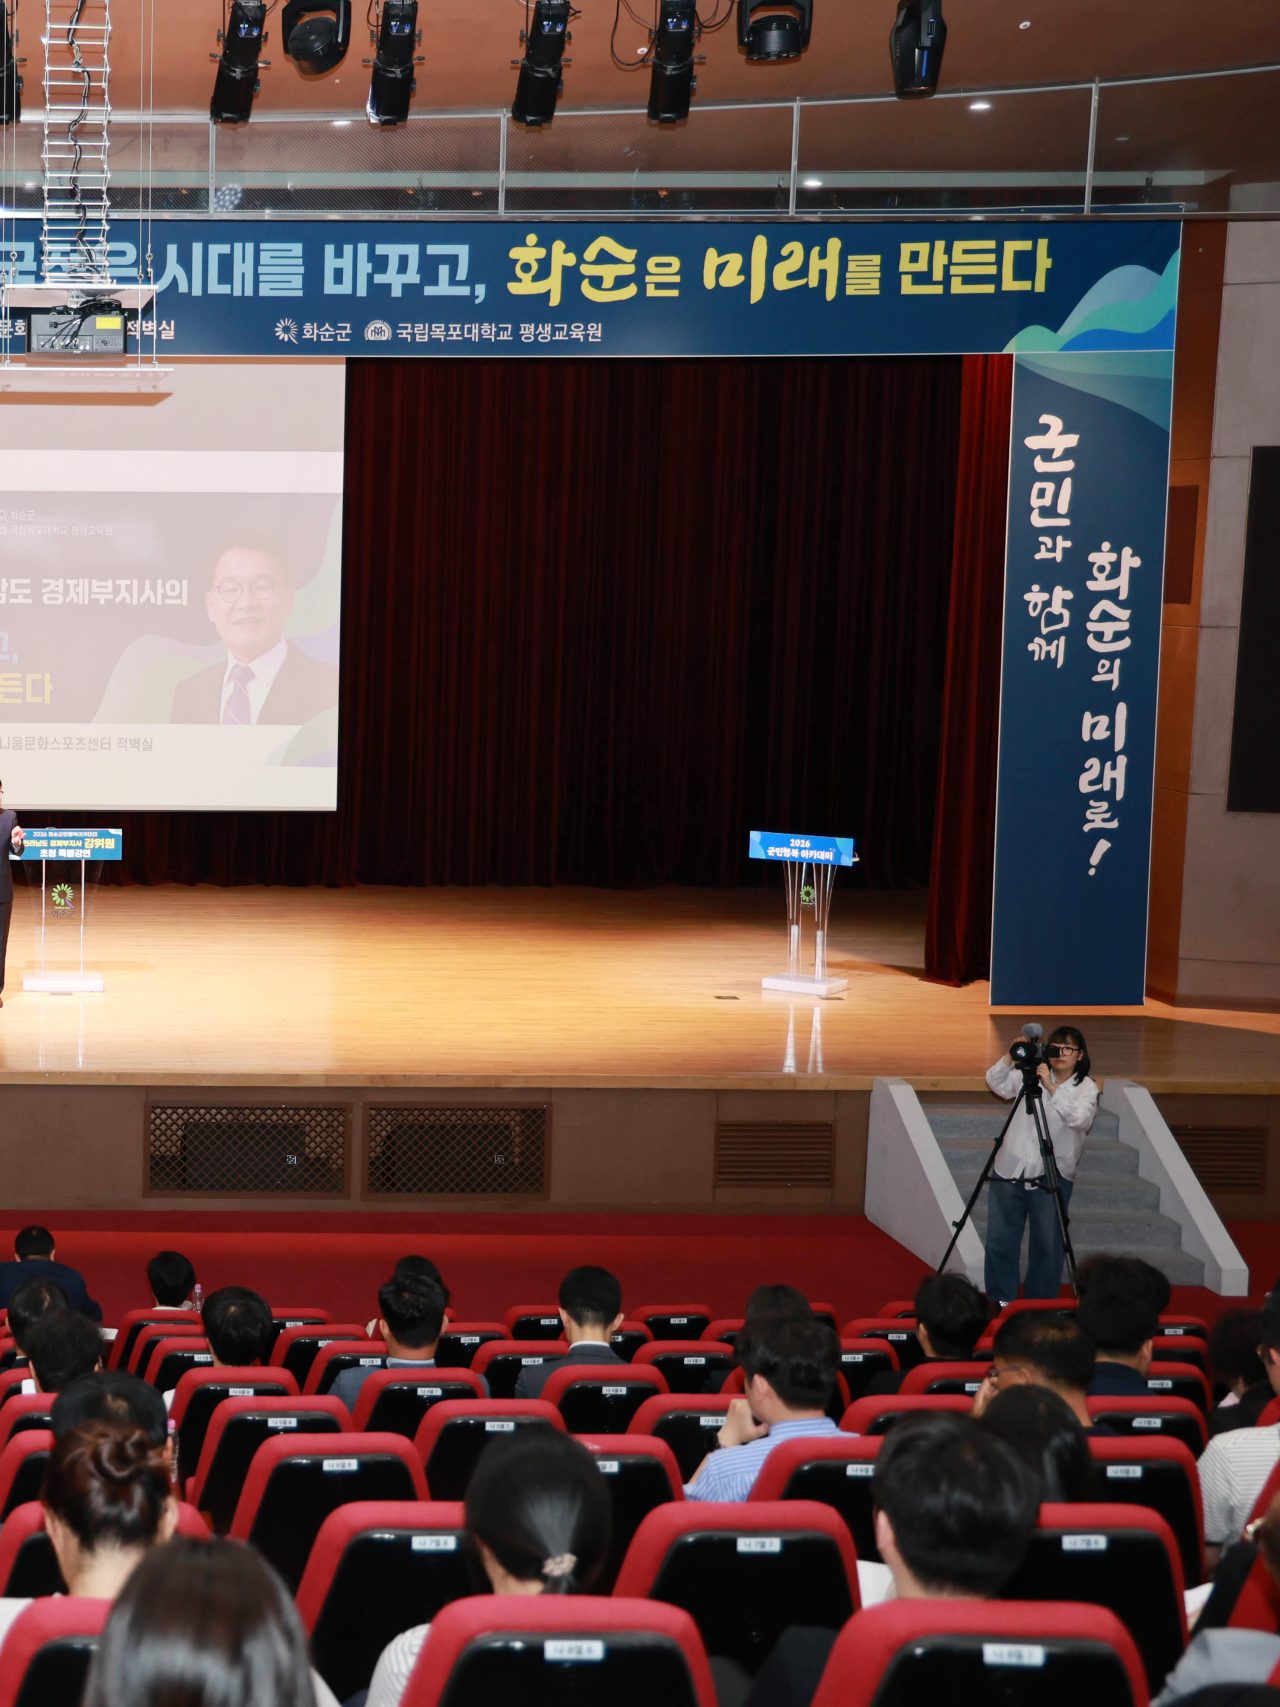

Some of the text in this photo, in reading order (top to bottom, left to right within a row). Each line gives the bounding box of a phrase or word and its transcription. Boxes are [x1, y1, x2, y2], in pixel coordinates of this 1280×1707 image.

[157, 242, 305, 297] 시대를
[323, 242, 486, 305] 바꾸고,
[506, 233, 681, 307] 화순은
[703, 234, 881, 305] 미래를
[898, 238, 1052, 295] 만든다
[302, 322, 352, 342] 화순군
[396, 322, 513, 343] 국립목포대학교
[519, 322, 603, 343] 평생교육원
[1023, 413, 1080, 669] 군민과 함께
[41, 578, 189, 606] 경제부지사의
[1078, 541, 1142, 876] 화순의 미래로!
[116, 736, 154, 752] 적벽실
[84, 838, 116, 849] 강위원
[789, 838, 811, 848] 2026
[766, 846, 834, 862] 군민행복 아카데미
